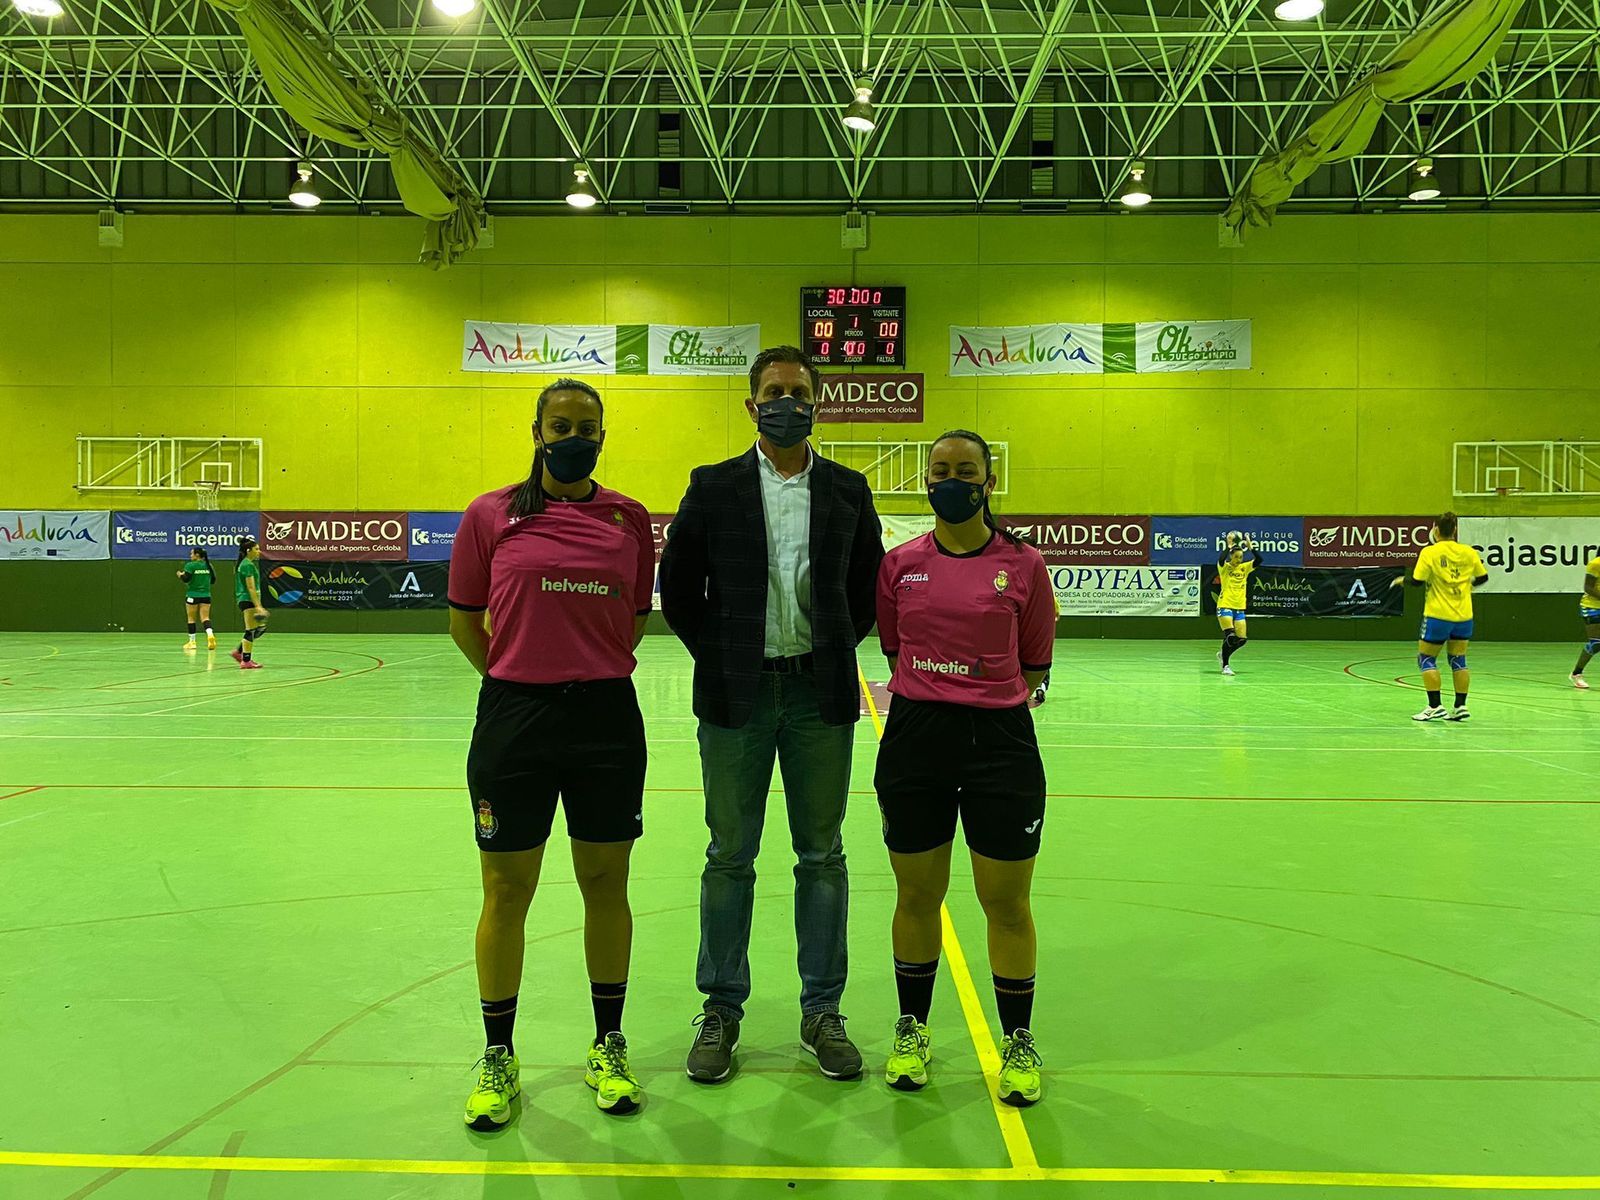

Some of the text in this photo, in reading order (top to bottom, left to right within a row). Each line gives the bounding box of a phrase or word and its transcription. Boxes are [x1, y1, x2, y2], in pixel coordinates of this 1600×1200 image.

[808, 309, 835, 317] LOCAL
[873, 309, 899, 317] VISITANTE
[815, 322, 833, 337] 00
[879, 322, 898, 337] 00
[466, 329, 608, 365] Andalucía
[821, 342, 829, 355] 0
[886, 342, 894, 355] 0
[952, 331, 1096, 368] Andalucía
[666, 357, 745, 365] AL JUEGO LIMPIO
[1153, 351, 1235, 362] AL JUEGO LIMPIO
[845, 406, 855, 414] de
[855, 406, 886, 415] Deportes
[135, 530, 168, 538] Diputación
[180, 524, 250, 534] somos lo que
[297, 520, 402, 541] IMDECO
[1036, 524, 1145, 545] IMDECO
[1260, 530, 1270, 538] lo
[1274, 531, 1293, 540] que
[1174, 536, 1208, 545] Diputación
[1215, 537, 1299, 552] hcemos
[266, 543, 294, 551] Instituto
[294, 544, 328, 553] Municipal
[328, 544, 338, 552] de
[340, 545, 371, 553] Deportes
[1068, 548, 1078, 556] de
[1080, 549, 1112, 557] Deportes
[1309, 550, 1338, 558] Instituto
[1339, 550, 1374, 559] Municipal
[1386, 551, 1418, 559] Deportes
[308, 570, 370, 586] Andalucía
[1047, 568, 1167, 590] OPYFAX
[1252, 576, 1316, 593] Andalucía
[541, 576, 609, 595] helvetia
[912, 656, 969, 675] helvetia
